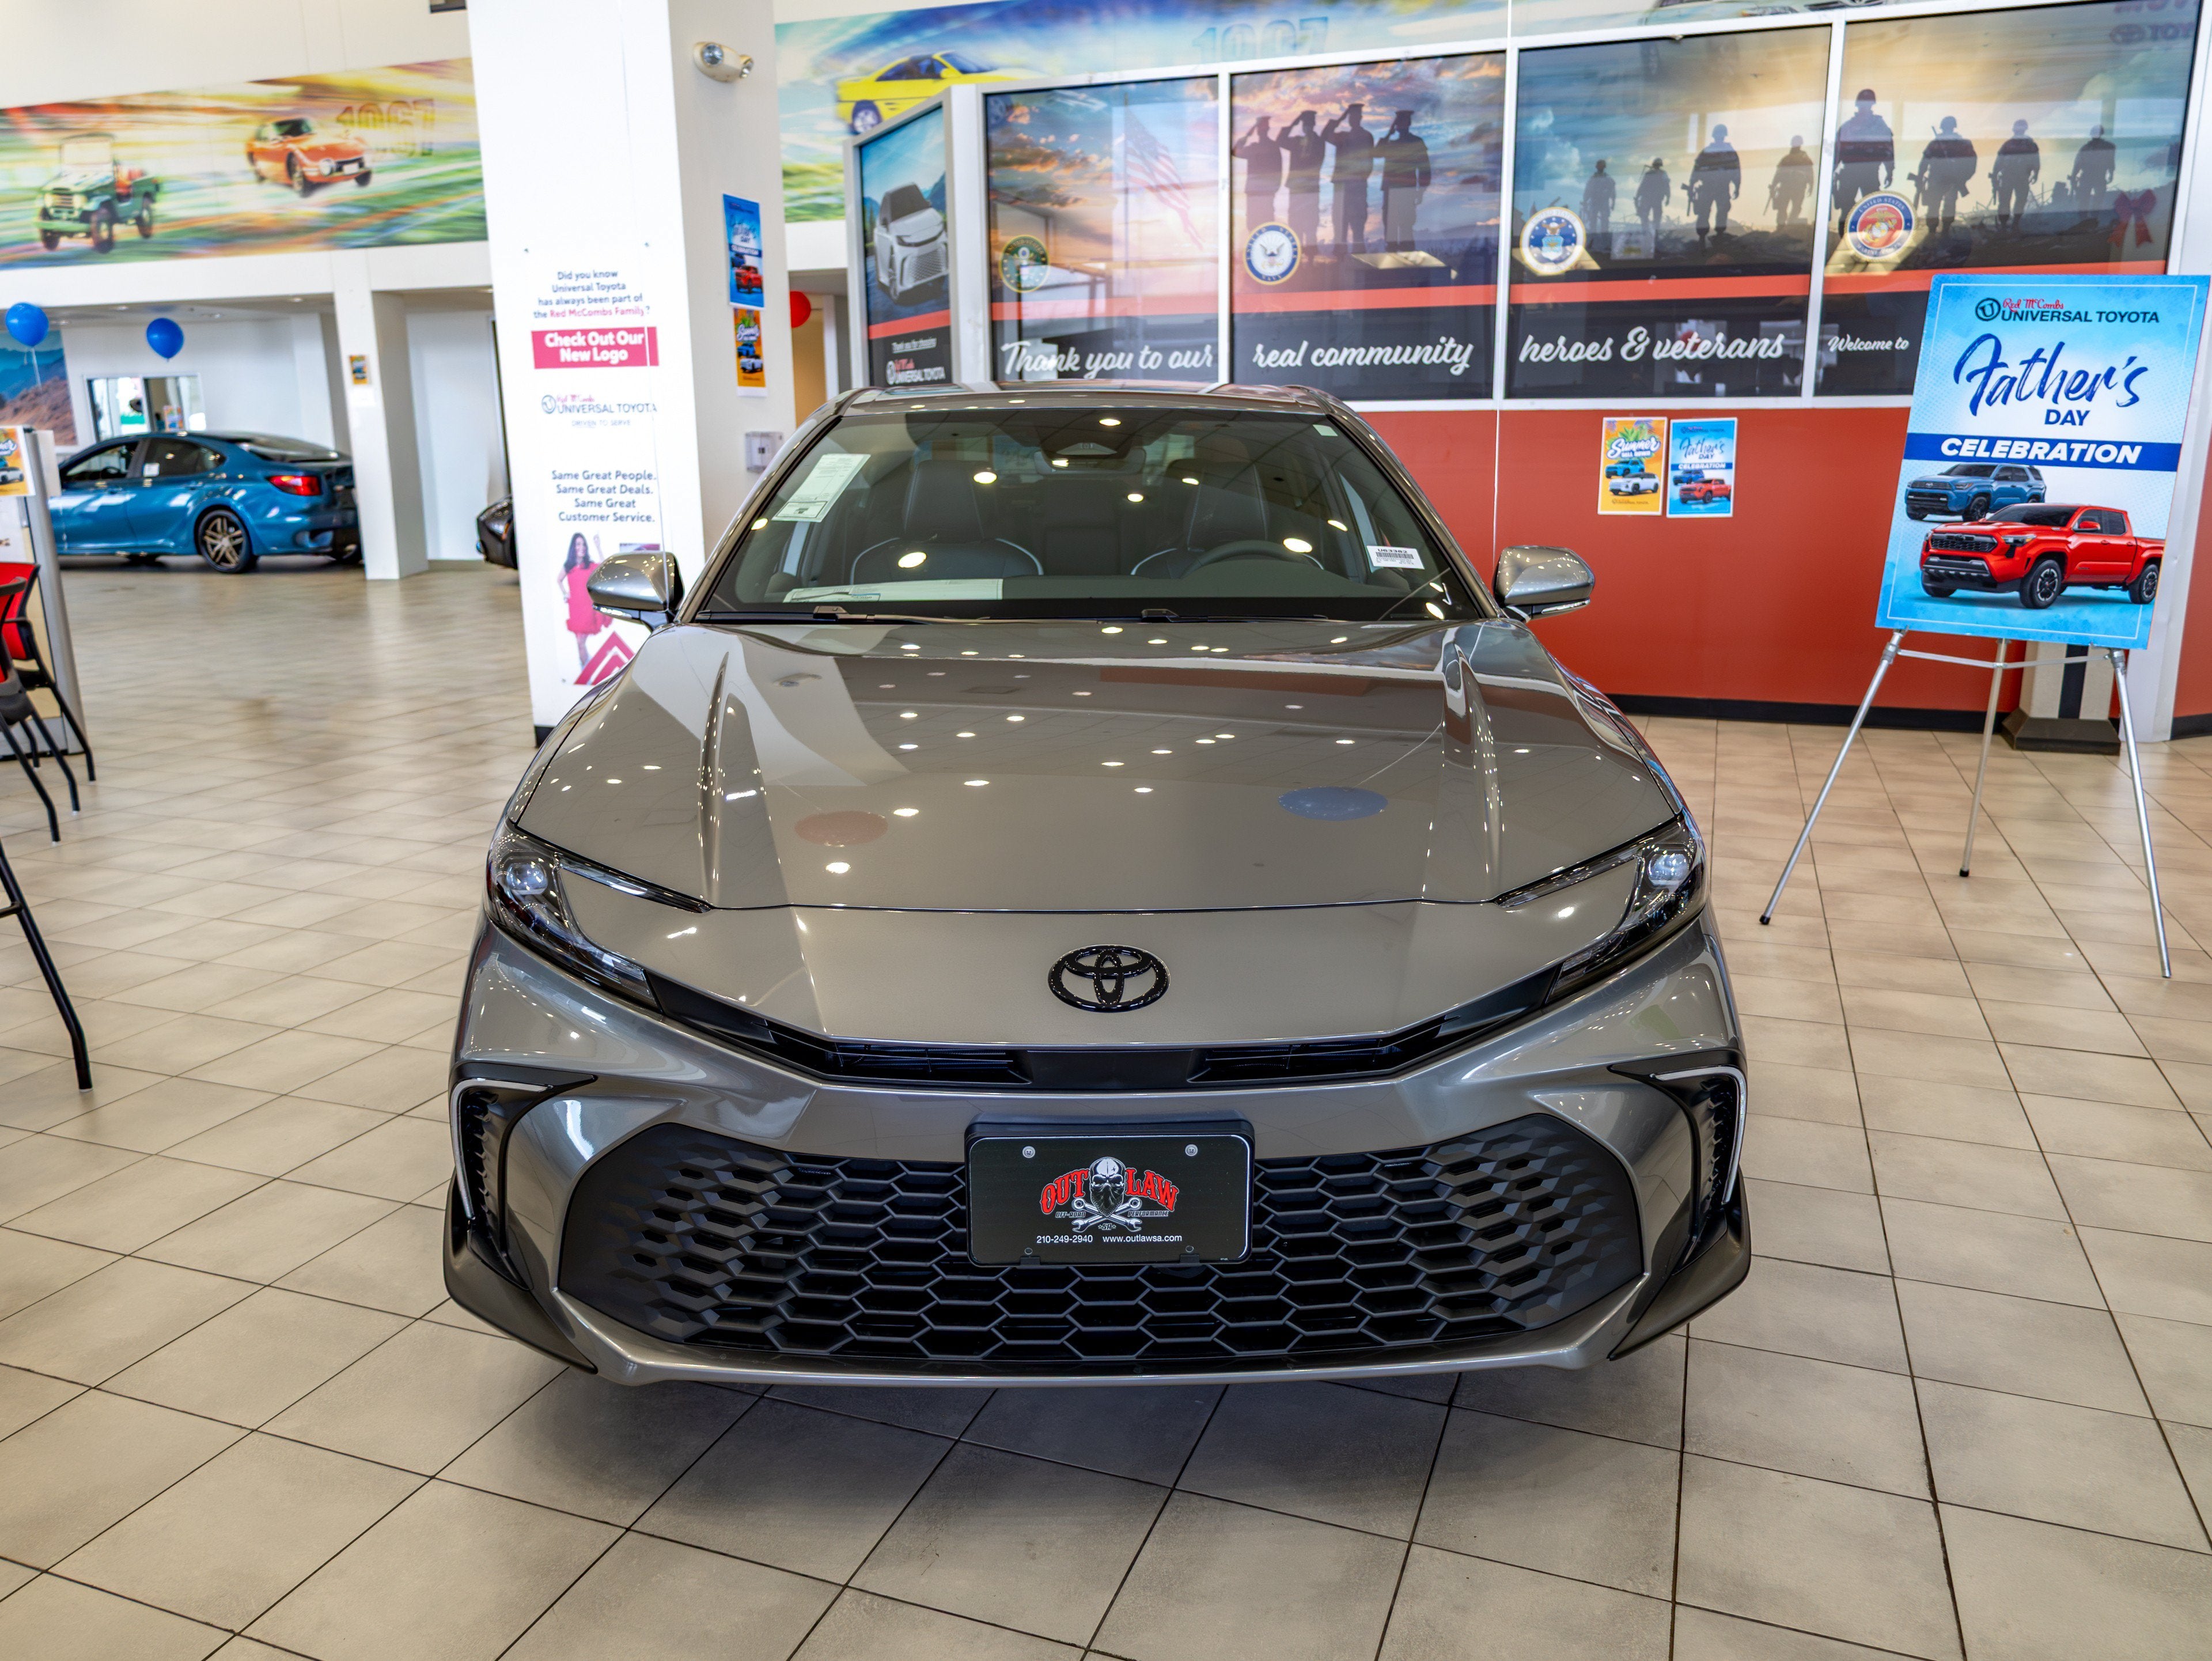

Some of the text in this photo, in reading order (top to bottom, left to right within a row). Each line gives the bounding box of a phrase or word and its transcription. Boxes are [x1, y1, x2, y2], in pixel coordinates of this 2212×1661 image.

[558, 270, 618, 281] Did you know
[552, 282, 626, 293] Universal Toyota
[538, 293, 643, 306] has always been part of
[2003, 298, 2021, 312] Red
[533, 311, 548, 319] the
[550, 309, 566, 317] Red
[569, 308, 612, 316] McCombs
[2001, 311, 2160, 323] UNIVERSAL TOYOTA
[544, 330, 644, 347] Check Out Our
[1518, 326, 1785, 362] heroes & veterans
[1828, 334, 1910, 353] Welcome to
[559, 347, 628, 364] New Logo
[1001, 340, 1213, 380] Thank you to our
[1252, 336, 1474, 376] real community
[1953, 333, 2148, 417] Father's
[557, 403, 658, 414] UNIVERSAL TOYOTA
[2044, 409, 2090, 426] DAY
[1607, 436, 1661, 460] Summer
[1679, 437, 1725, 458] Father's
[1941, 438, 2142, 464] CELEBRATION
[552, 470, 657, 482] Same Great People.
[556, 484, 654, 494] Same Great Deals.
[574, 498, 637, 508] Same Great
[558, 511, 656, 522] Customer Service.
[1036, 1234, 1183, 1243] 210-249-2940 www.outlawsa.com
